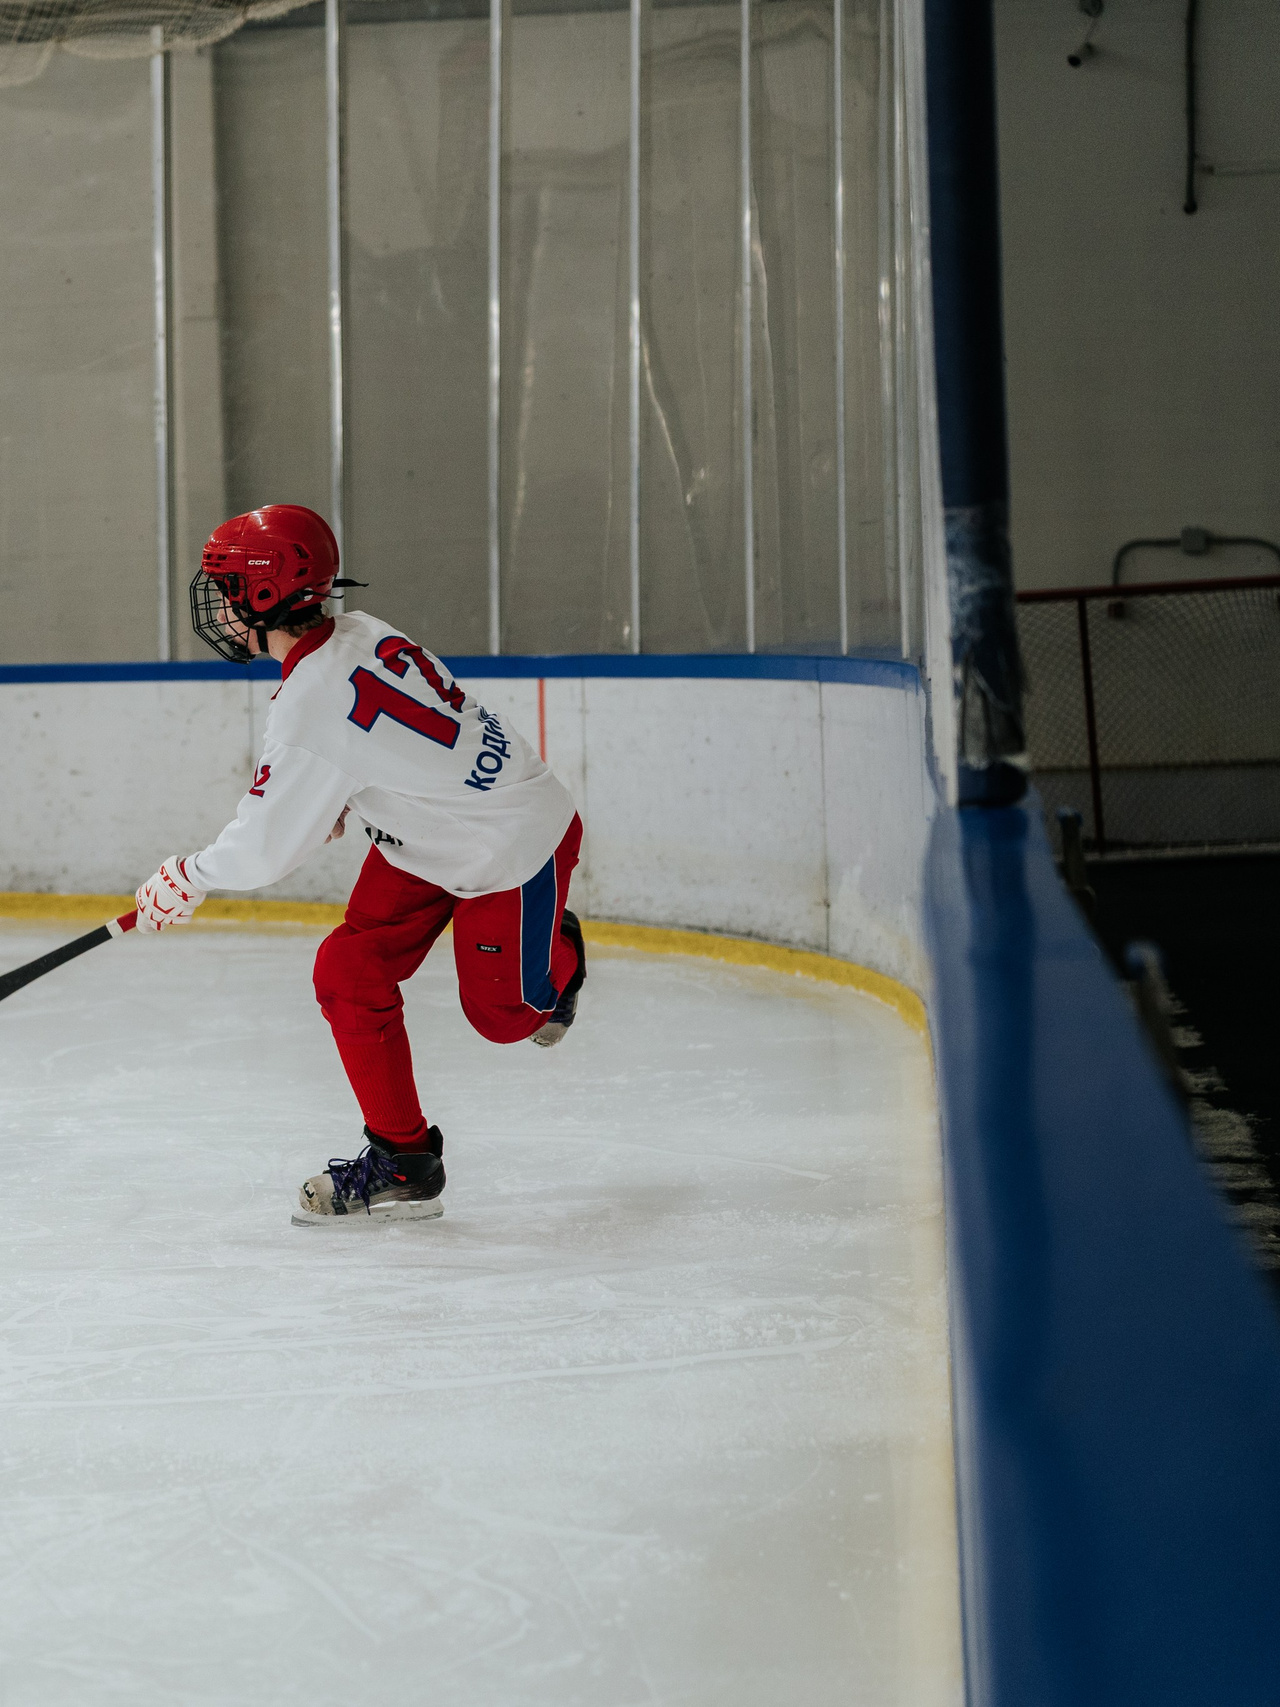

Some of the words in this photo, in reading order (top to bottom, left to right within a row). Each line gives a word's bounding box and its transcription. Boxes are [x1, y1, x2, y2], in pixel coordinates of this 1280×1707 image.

[347, 635, 466, 750] 12
[248, 759, 272, 798] 2
[464, 706, 511, 791] КОДИ
[159, 865, 196, 903] STEX
